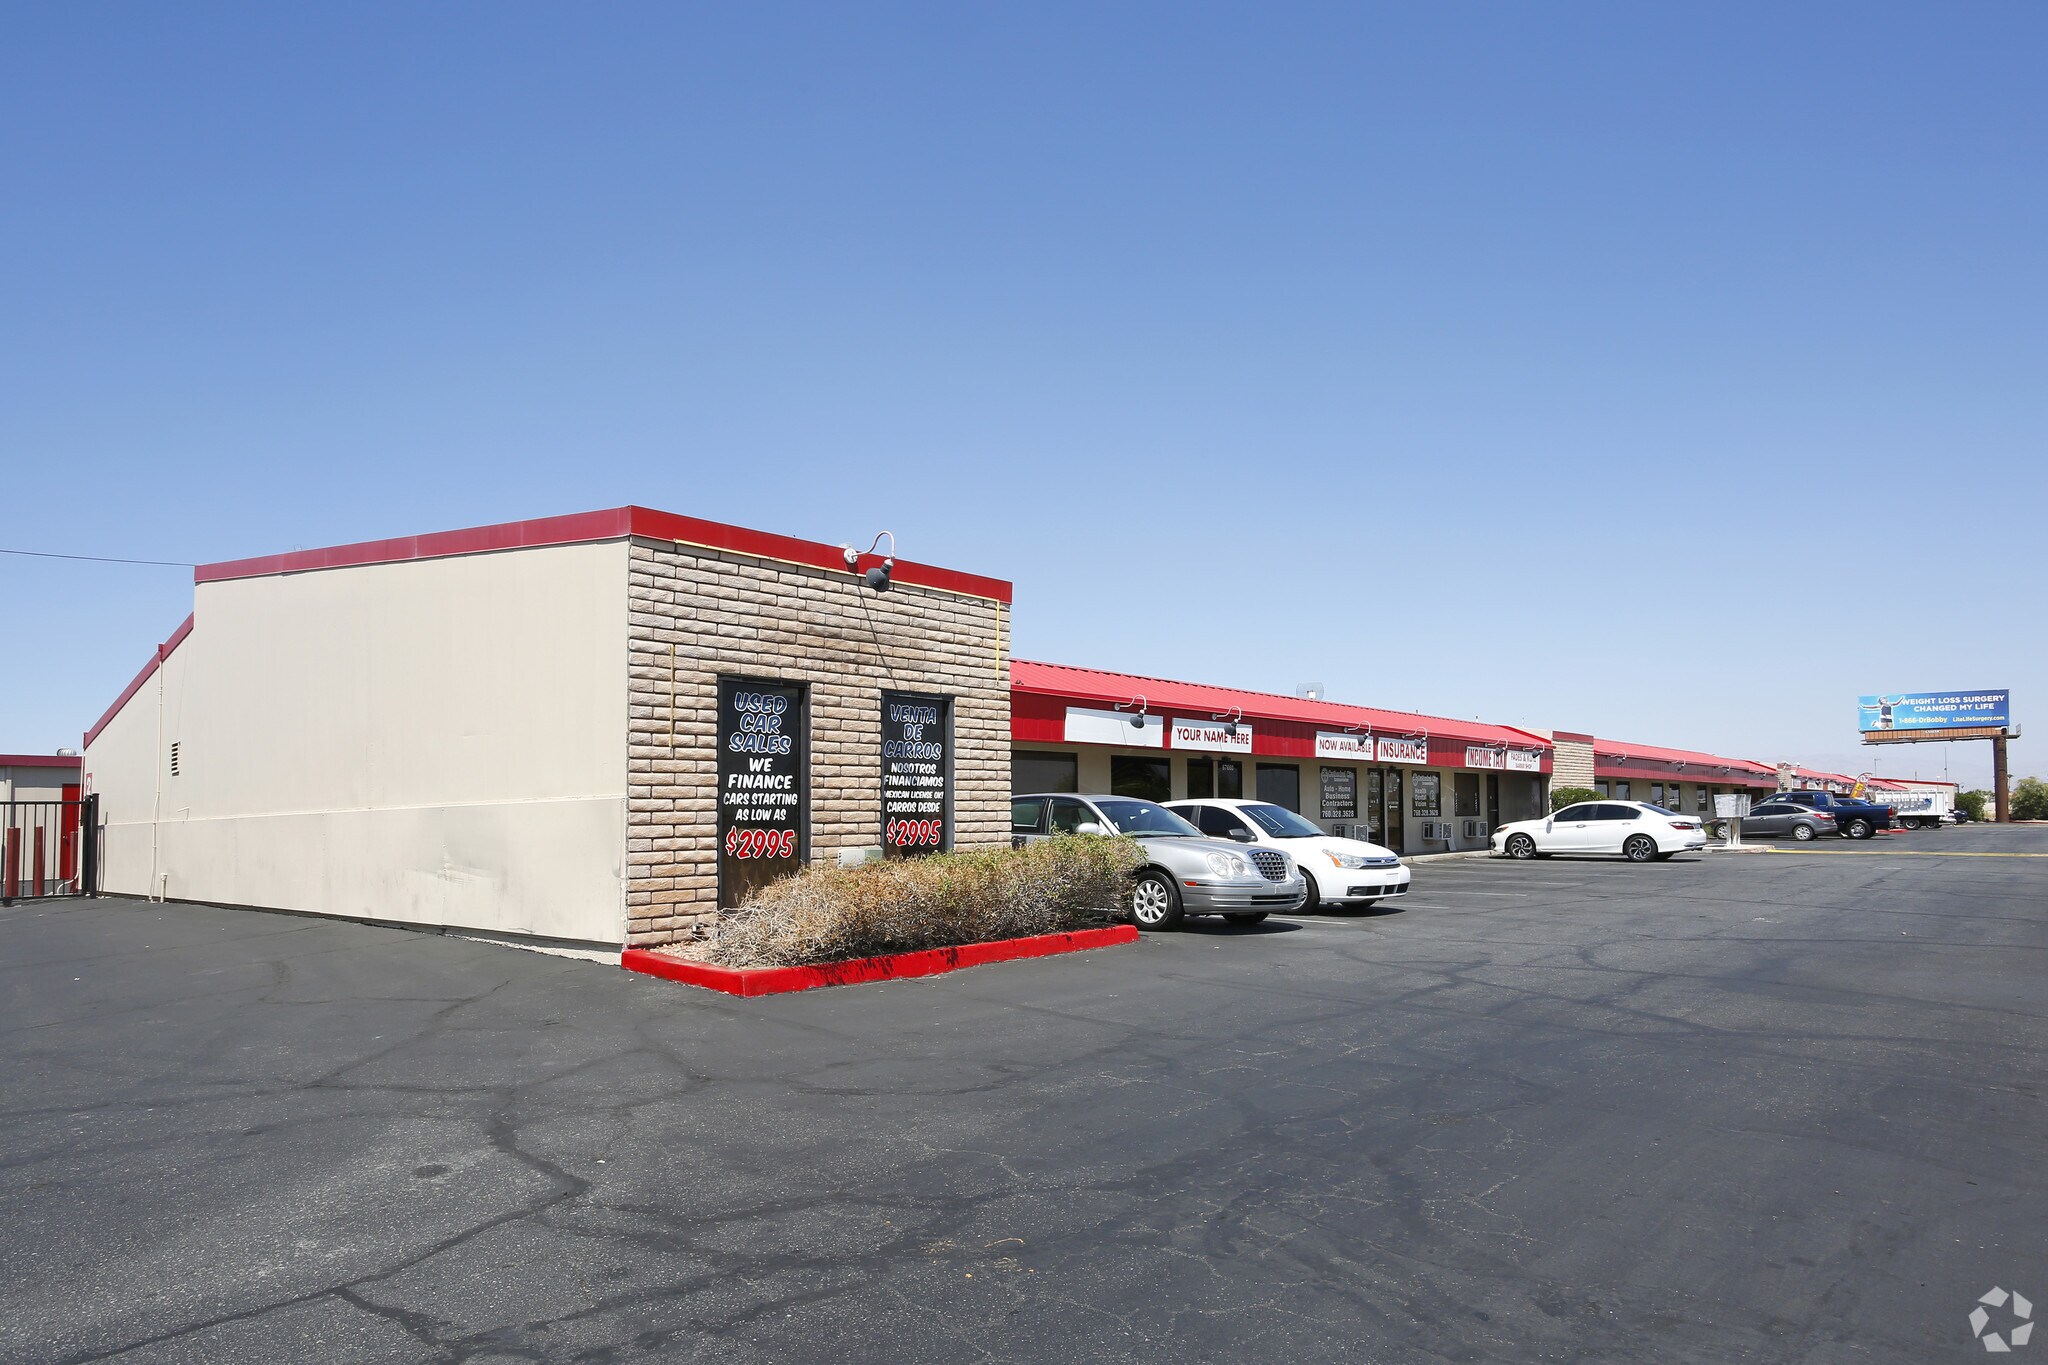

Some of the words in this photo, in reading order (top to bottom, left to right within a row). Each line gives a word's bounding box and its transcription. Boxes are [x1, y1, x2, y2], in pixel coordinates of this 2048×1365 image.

[734, 692, 788, 714] USED
[1963, 695, 2005, 703] SURGERY
[890, 704, 936, 724] VENTA
[1914, 704, 1957, 712] CHANGED
[739, 713, 782, 734] CAR
[903, 723, 923, 741] DE
[1177, 728, 1201, 741] YOUR
[1204, 728, 1228, 743] NAME
[1230, 733, 1249, 744] HERE
[728, 732, 792, 755] SALES
[884, 740, 942, 760] CARROS
[1320, 739, 1338, 751] NOW
[1339, 741, 1371, 753] AVAILABLE
[1380, 742, 1425, 760] INSURANCE
[749, 758, 773, 772] WE
[1467, 748, 1491, 767] INCOME
[1492, 750, 1504, 768] TAX
[891, 763, 936, 774] NOSOTROS
[728, 774, 793, 789] FINANCE
[884, 775, 944, 787] FINANCIAMOS
[723, 792, 749, 805] CARS
[751, 793, 798, 805] STARTING
[884, 790, 910, 799] MEXICAN
[911, 791, 933, 799] LICENSE
[887, 801, 917, 813] CARROS
[918, 802, 940, 813] DESDE
[1322, 799, 1353, 807] Contractors
[735, 808, 749, 820] AS
[751, 809, 772, 820] LOW
[773, 809, 787, 820] AS
[886, 816, 941, 846] $2995
[725, 825, 795, 859] $2995
